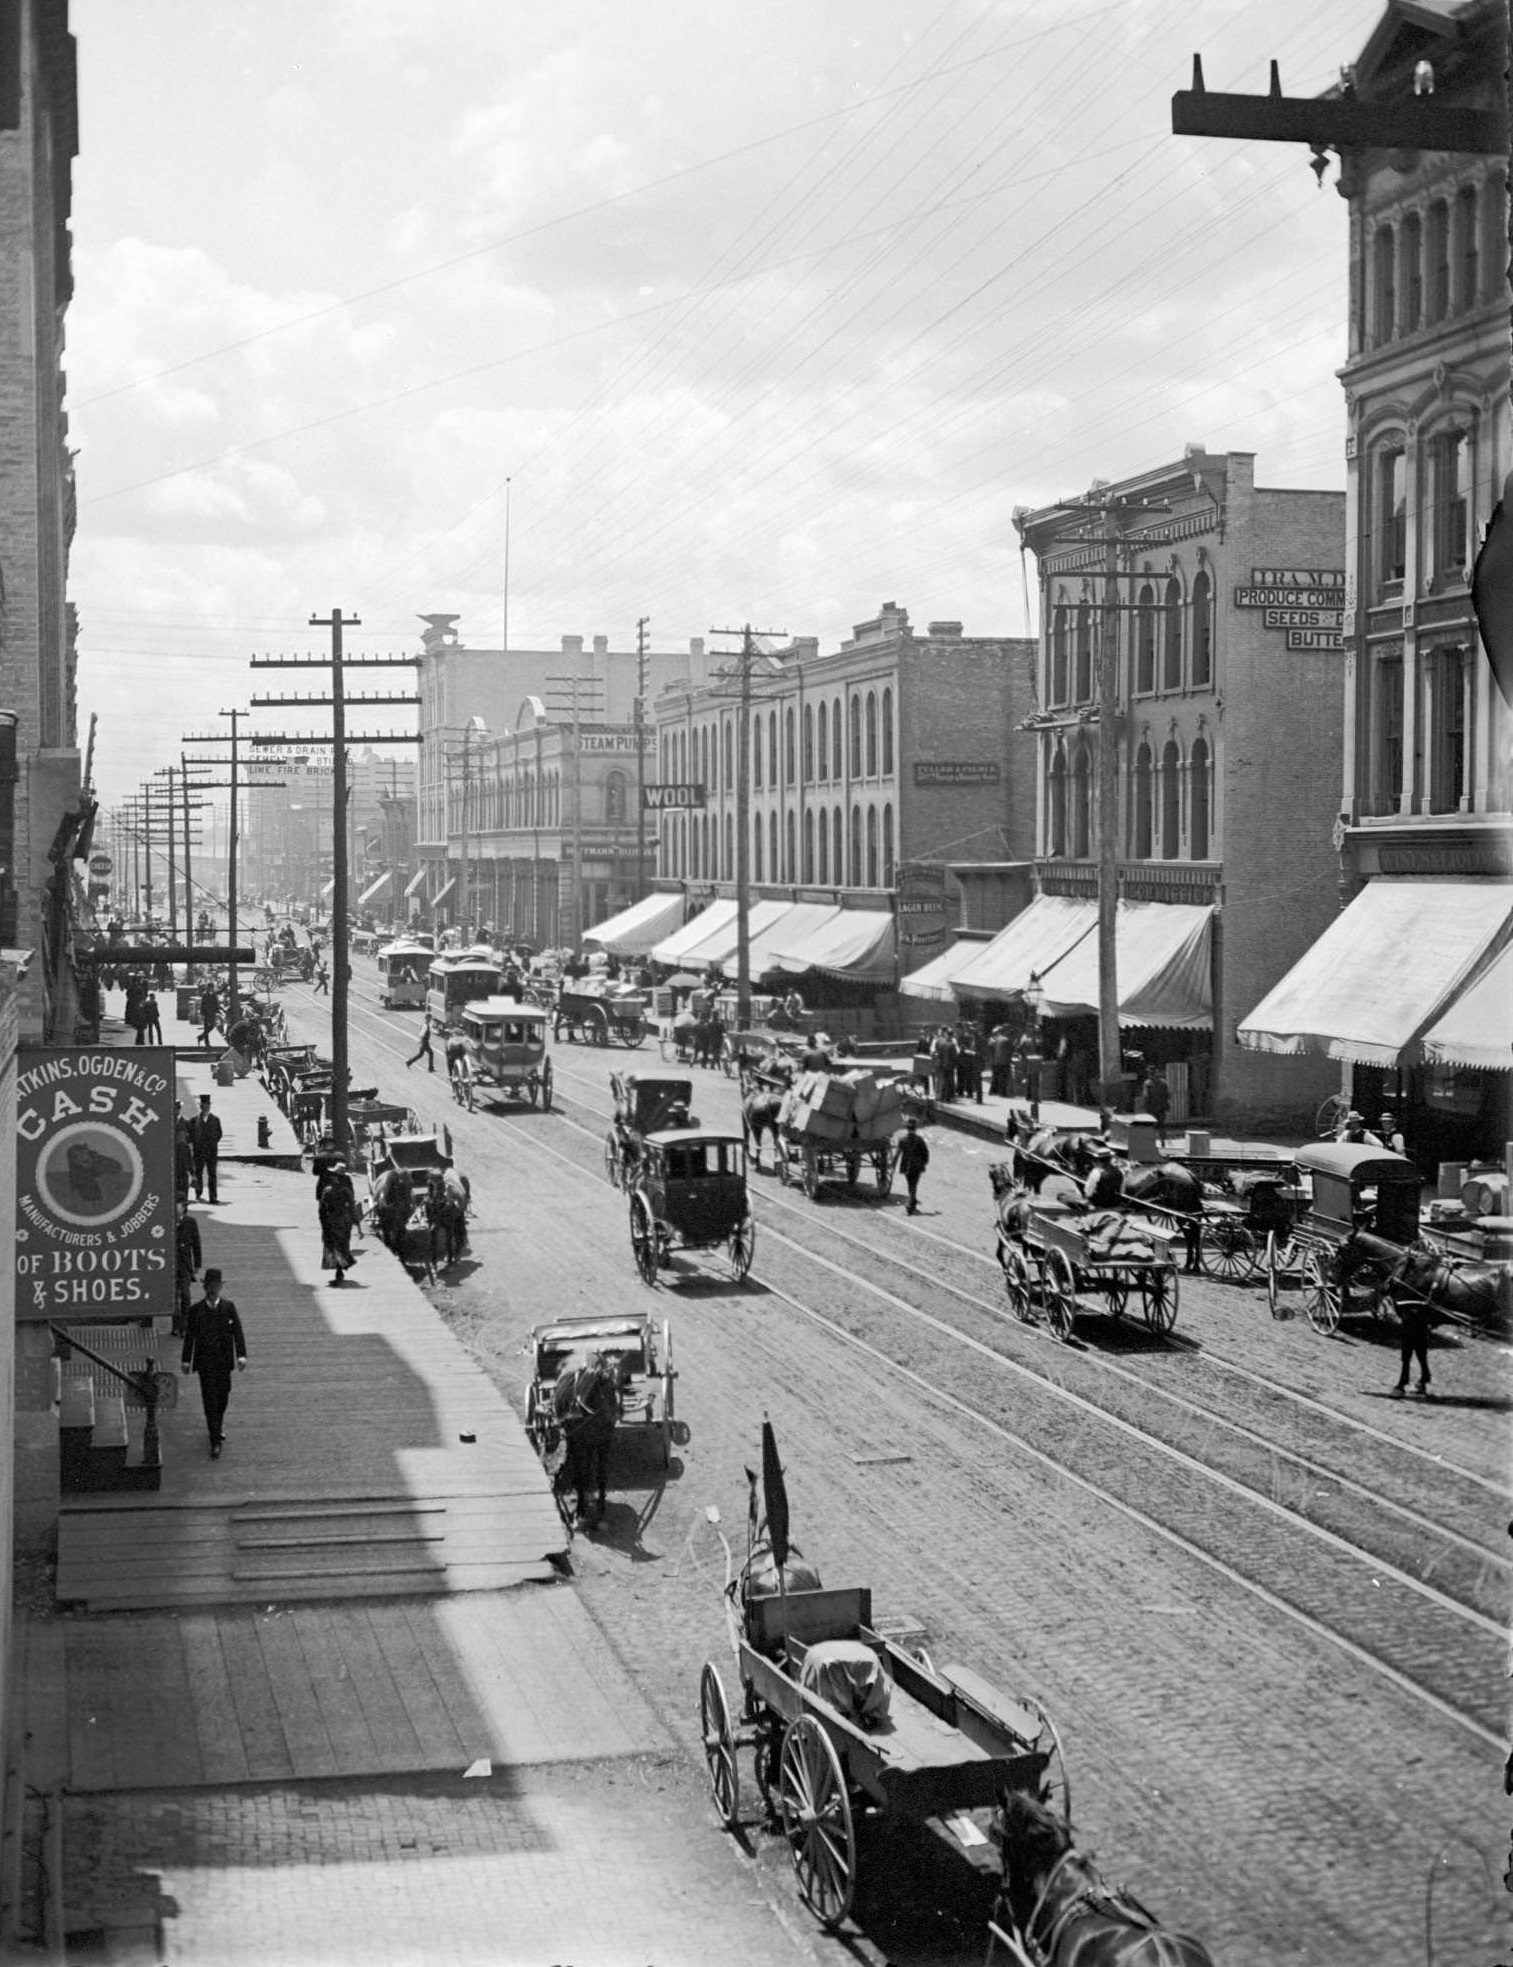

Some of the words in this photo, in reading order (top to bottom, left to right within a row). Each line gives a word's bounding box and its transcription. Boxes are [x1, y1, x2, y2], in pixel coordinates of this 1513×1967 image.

[1240, 589, 1303, 605] PRODUCE
[1268, 611, 1319, 625] SEEDS
[296, 747, 326, 755] DRAIN
[278, 766, 300, 775] FIRE
[645, 787, 701, 806] WOOL
[898, 903, 921, 913] LAGER
[923, 902, 943, 912] BEER
[79, 1055, 138, 1082] OGDEN
[133, 1070, 147, 1087] &
[17, 1085, 160, 1140] CASH
[18, 1194, 103, 1246] MANUFACTURERS
[106, 1230, 118, 1243] &
[120, 1193, 160, 1238] JOBBERS
[17, 1254, 43, 1274] OF
[52, 1248, 166, 1273] BOOTS
[54, 1277, 150, 1303] SHOES.
